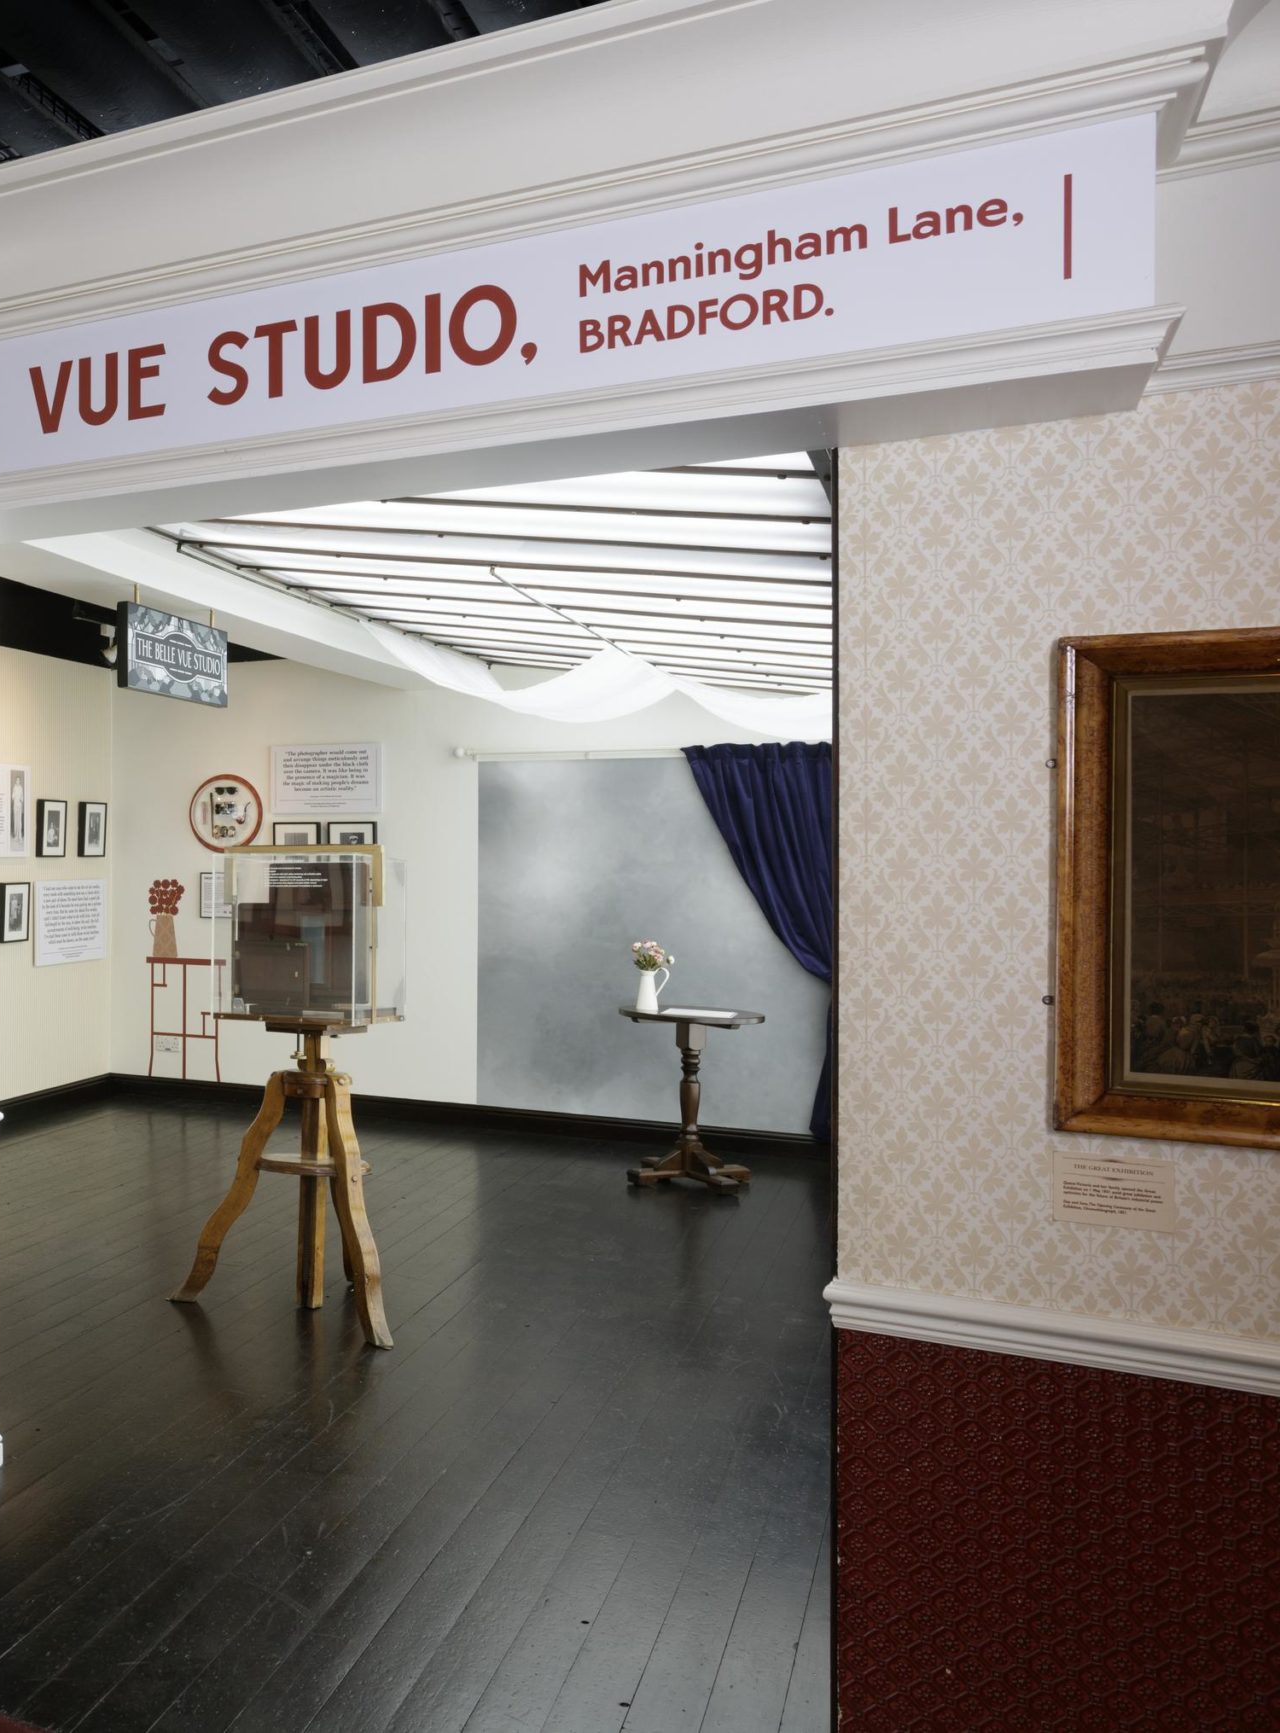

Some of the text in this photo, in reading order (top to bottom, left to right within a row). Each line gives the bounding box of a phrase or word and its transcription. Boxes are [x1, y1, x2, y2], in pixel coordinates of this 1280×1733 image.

[580, 199, 1022, 302] Manningham Lane,
[579, 280, 832, 352] BRADFORD.
[30, 345, 163, 432] VUE
[209, 286, 536, 404] STUDIO,
[137, 637, 220, 675] THE BELLE VUE STUDIO
[1112, 1168, 1154, 1176] EXHIBITION
